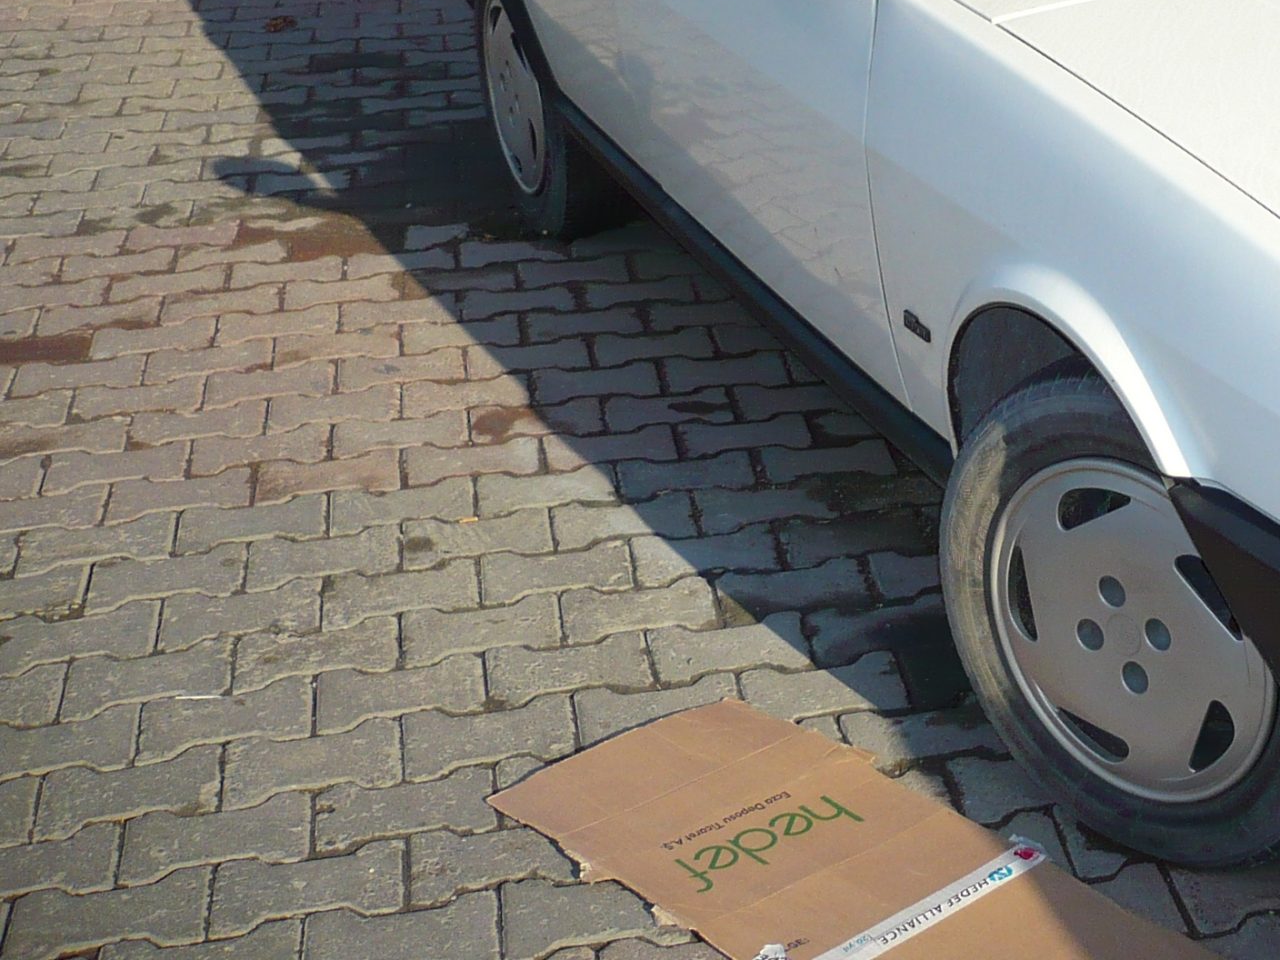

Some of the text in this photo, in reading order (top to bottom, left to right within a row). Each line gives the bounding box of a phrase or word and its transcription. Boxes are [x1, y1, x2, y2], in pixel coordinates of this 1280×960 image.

[765, 791, 792, 805] Ecza
[723, 803, 766, 824] Deposu
[685, 821, 725, 841] Ticaret
[674, 794, 865, 894] hedef
[879, 878, 990, 945] HEDEF ALLIANCE
